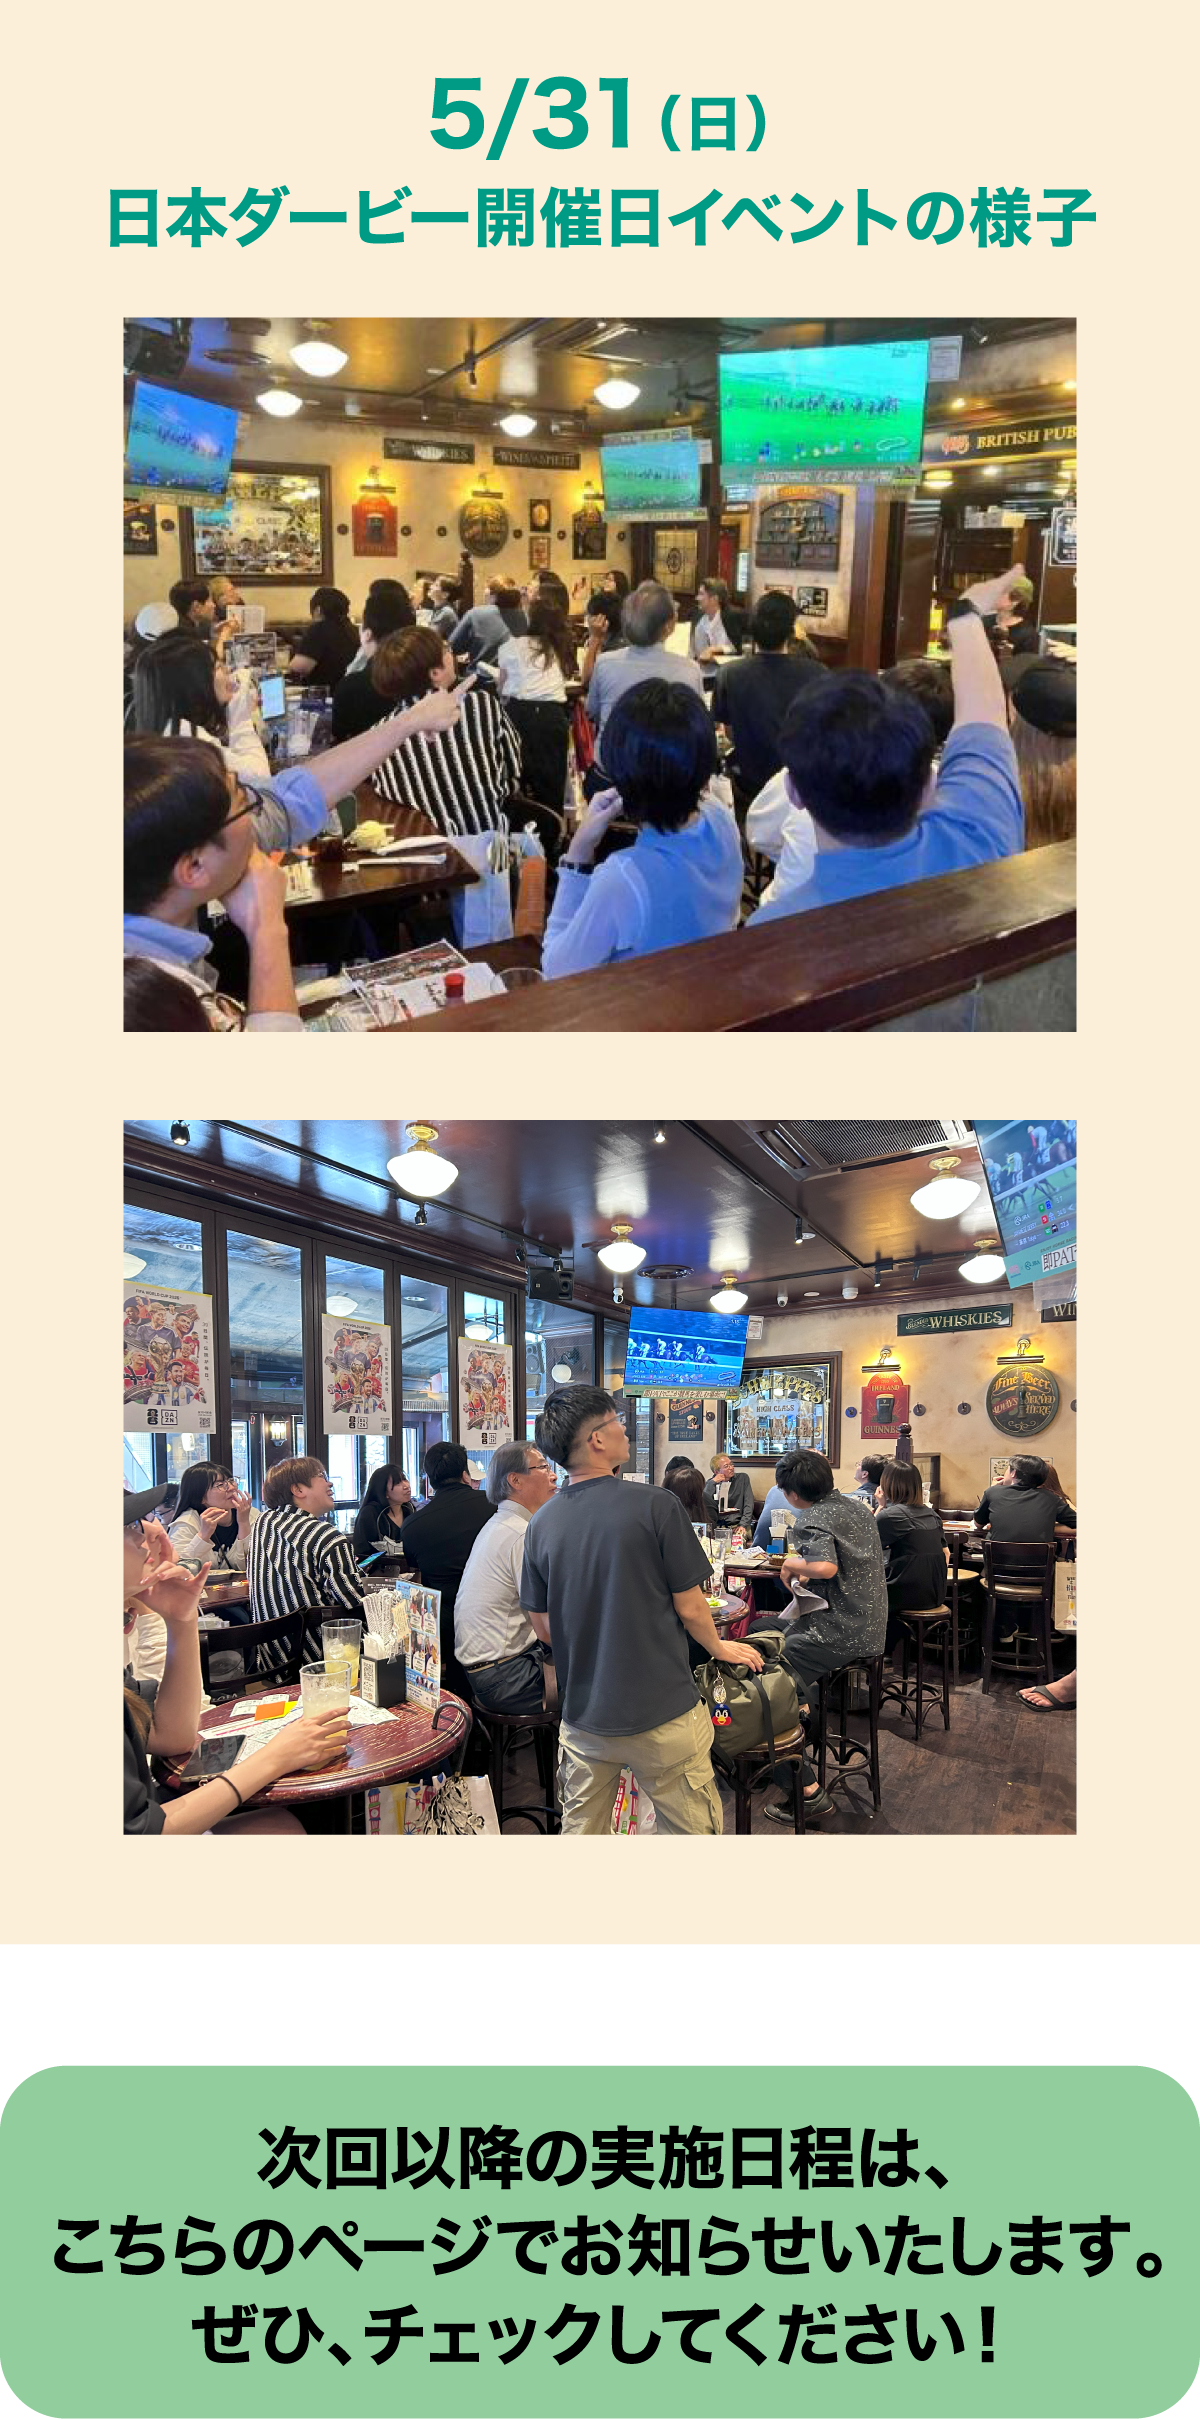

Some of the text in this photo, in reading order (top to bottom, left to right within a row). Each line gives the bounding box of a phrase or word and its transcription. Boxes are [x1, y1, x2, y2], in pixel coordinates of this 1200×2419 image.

[976, 430, 1039, 450] BRITISH
[1043, 424, 1076, 441] PUB
[1042, 1244, 1076, 1271] 即PAT
[929, 1310, 1002, 1329] WHISKIES
[994, 1371, 1051, 1392] Fine Beer
[756, 1404, 795, 1413] HIGH CLASS
[863, 1425, 900, 1435] GUINNES
